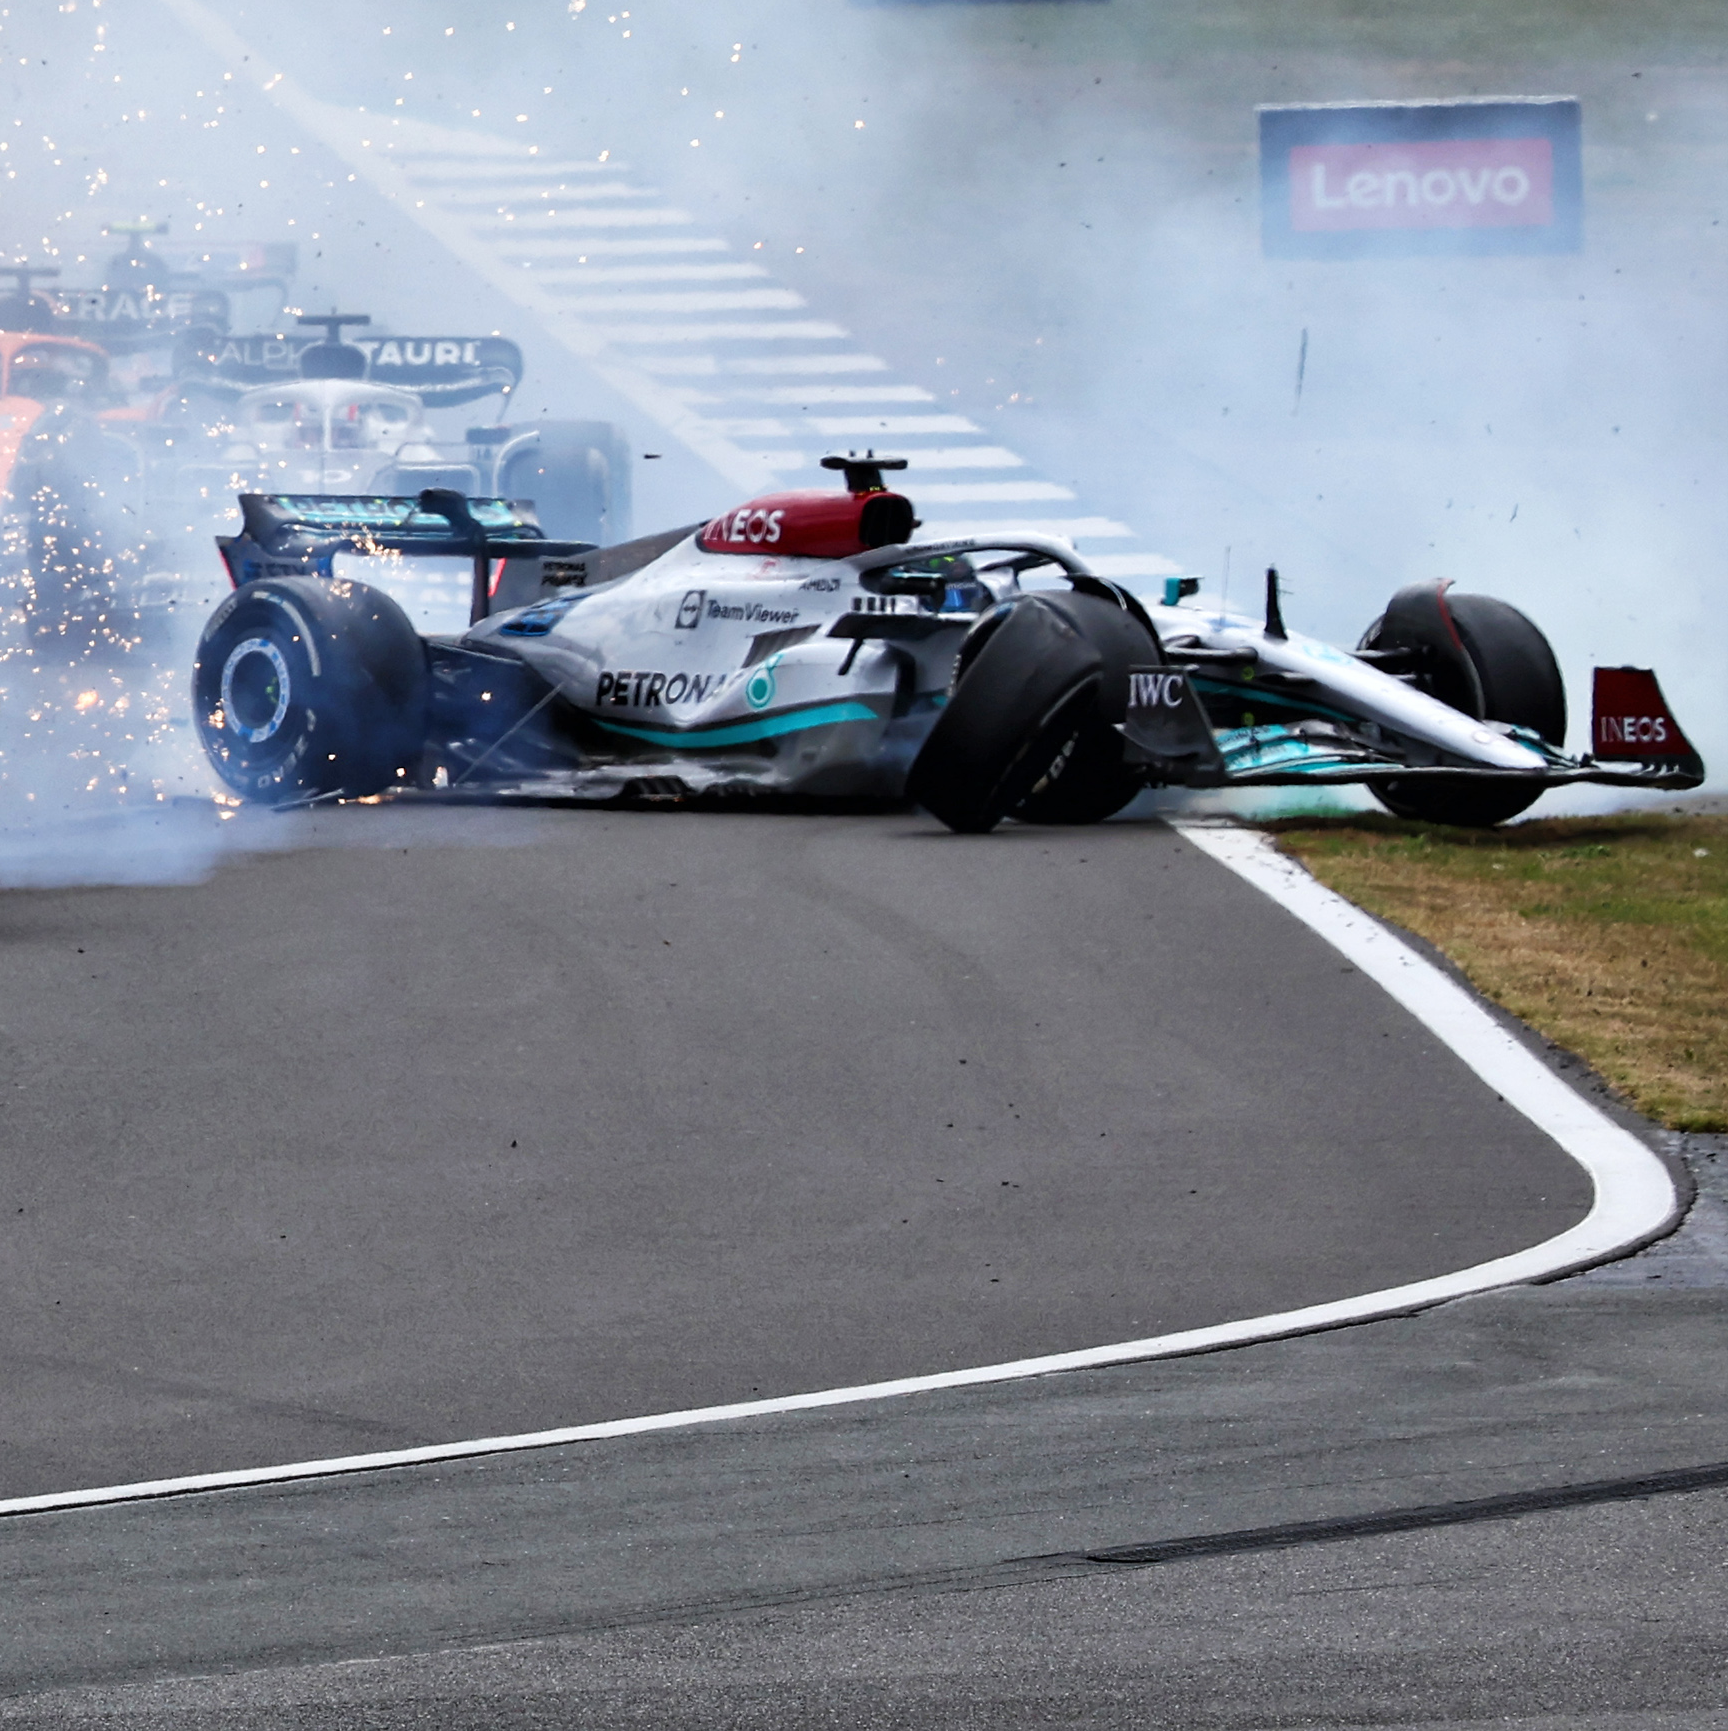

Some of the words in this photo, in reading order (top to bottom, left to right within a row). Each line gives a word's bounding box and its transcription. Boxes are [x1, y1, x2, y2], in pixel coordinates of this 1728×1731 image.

[1312, 163, 1531, 211] Lenovo
[705, 600, 800, 625] TeamViewer
[1128, 673, 1184, 709] IWC
[1599, 715, 1667, 743] INEOS
